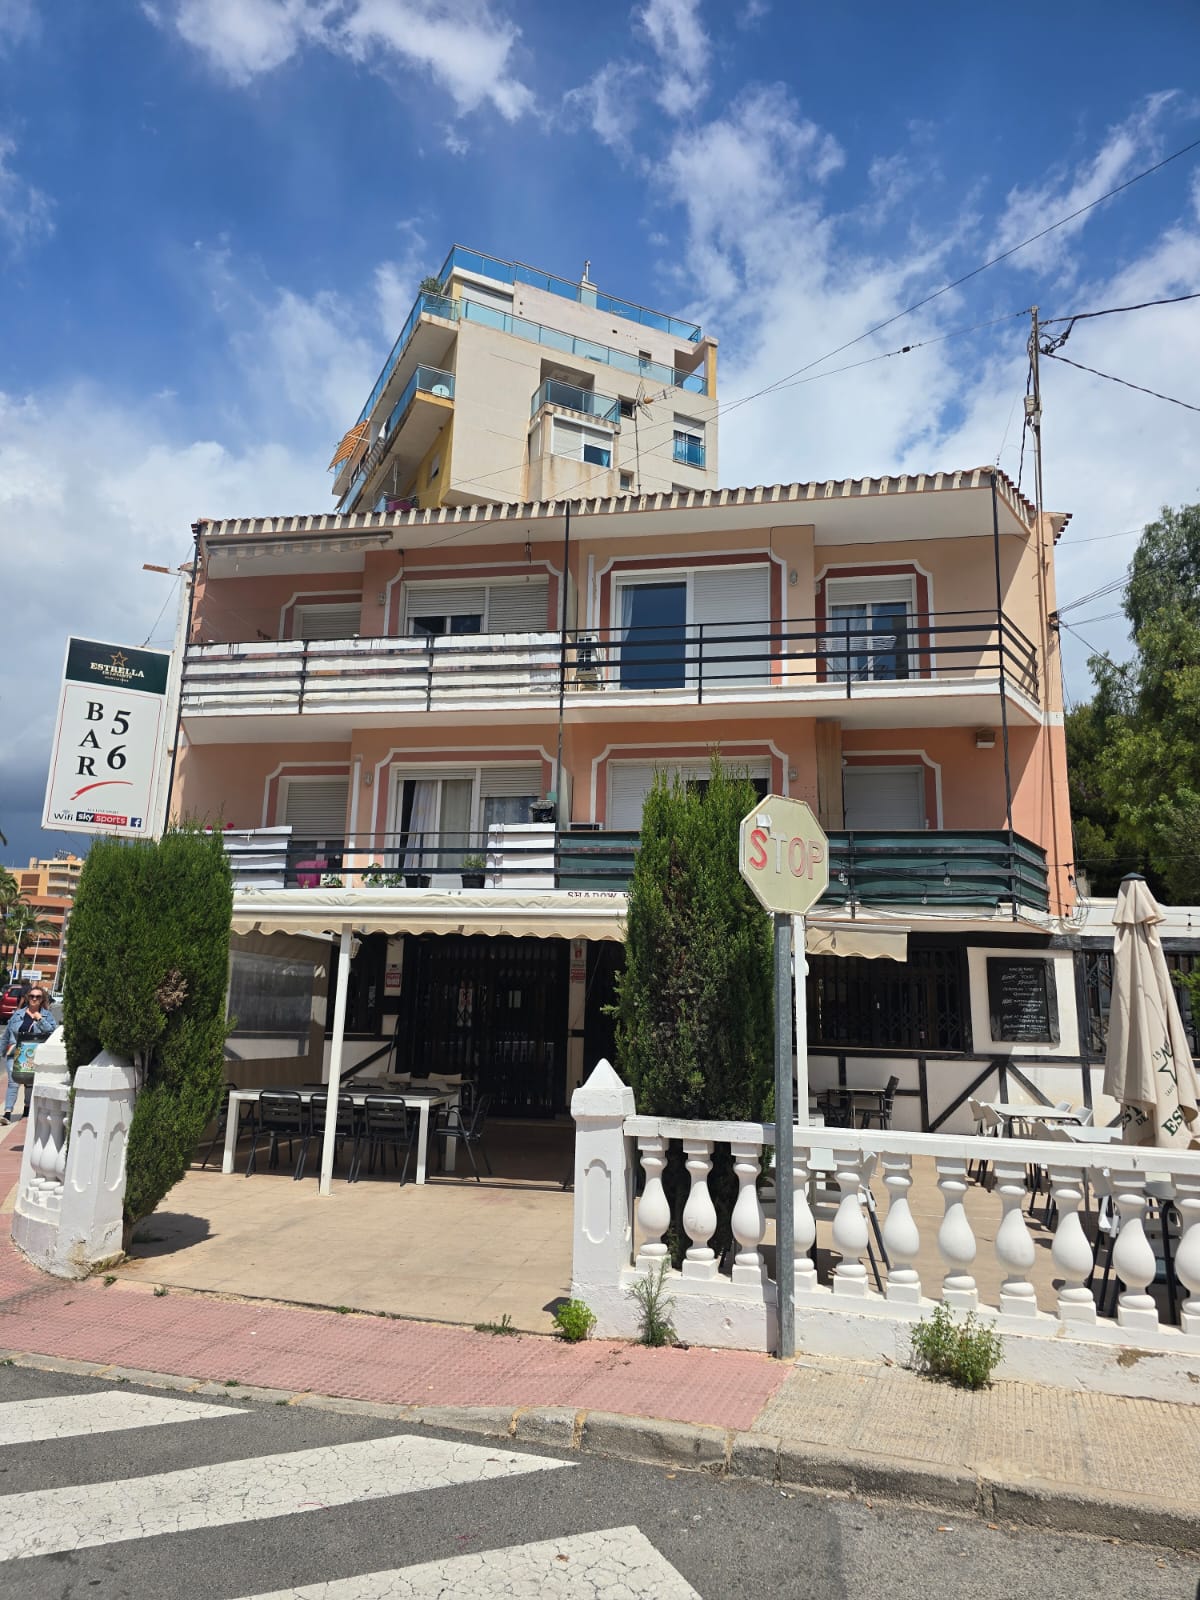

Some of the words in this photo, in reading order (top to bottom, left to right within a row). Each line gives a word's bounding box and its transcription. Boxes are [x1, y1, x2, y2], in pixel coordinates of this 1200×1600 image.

[90, 662, 144, 678] ESTRELLA
[76, 701, 104, 777] BAR
[78, 813, 94, 822] sky
[95, 815, 126, 825] sports
[749, 829, 824, 880] STOP
